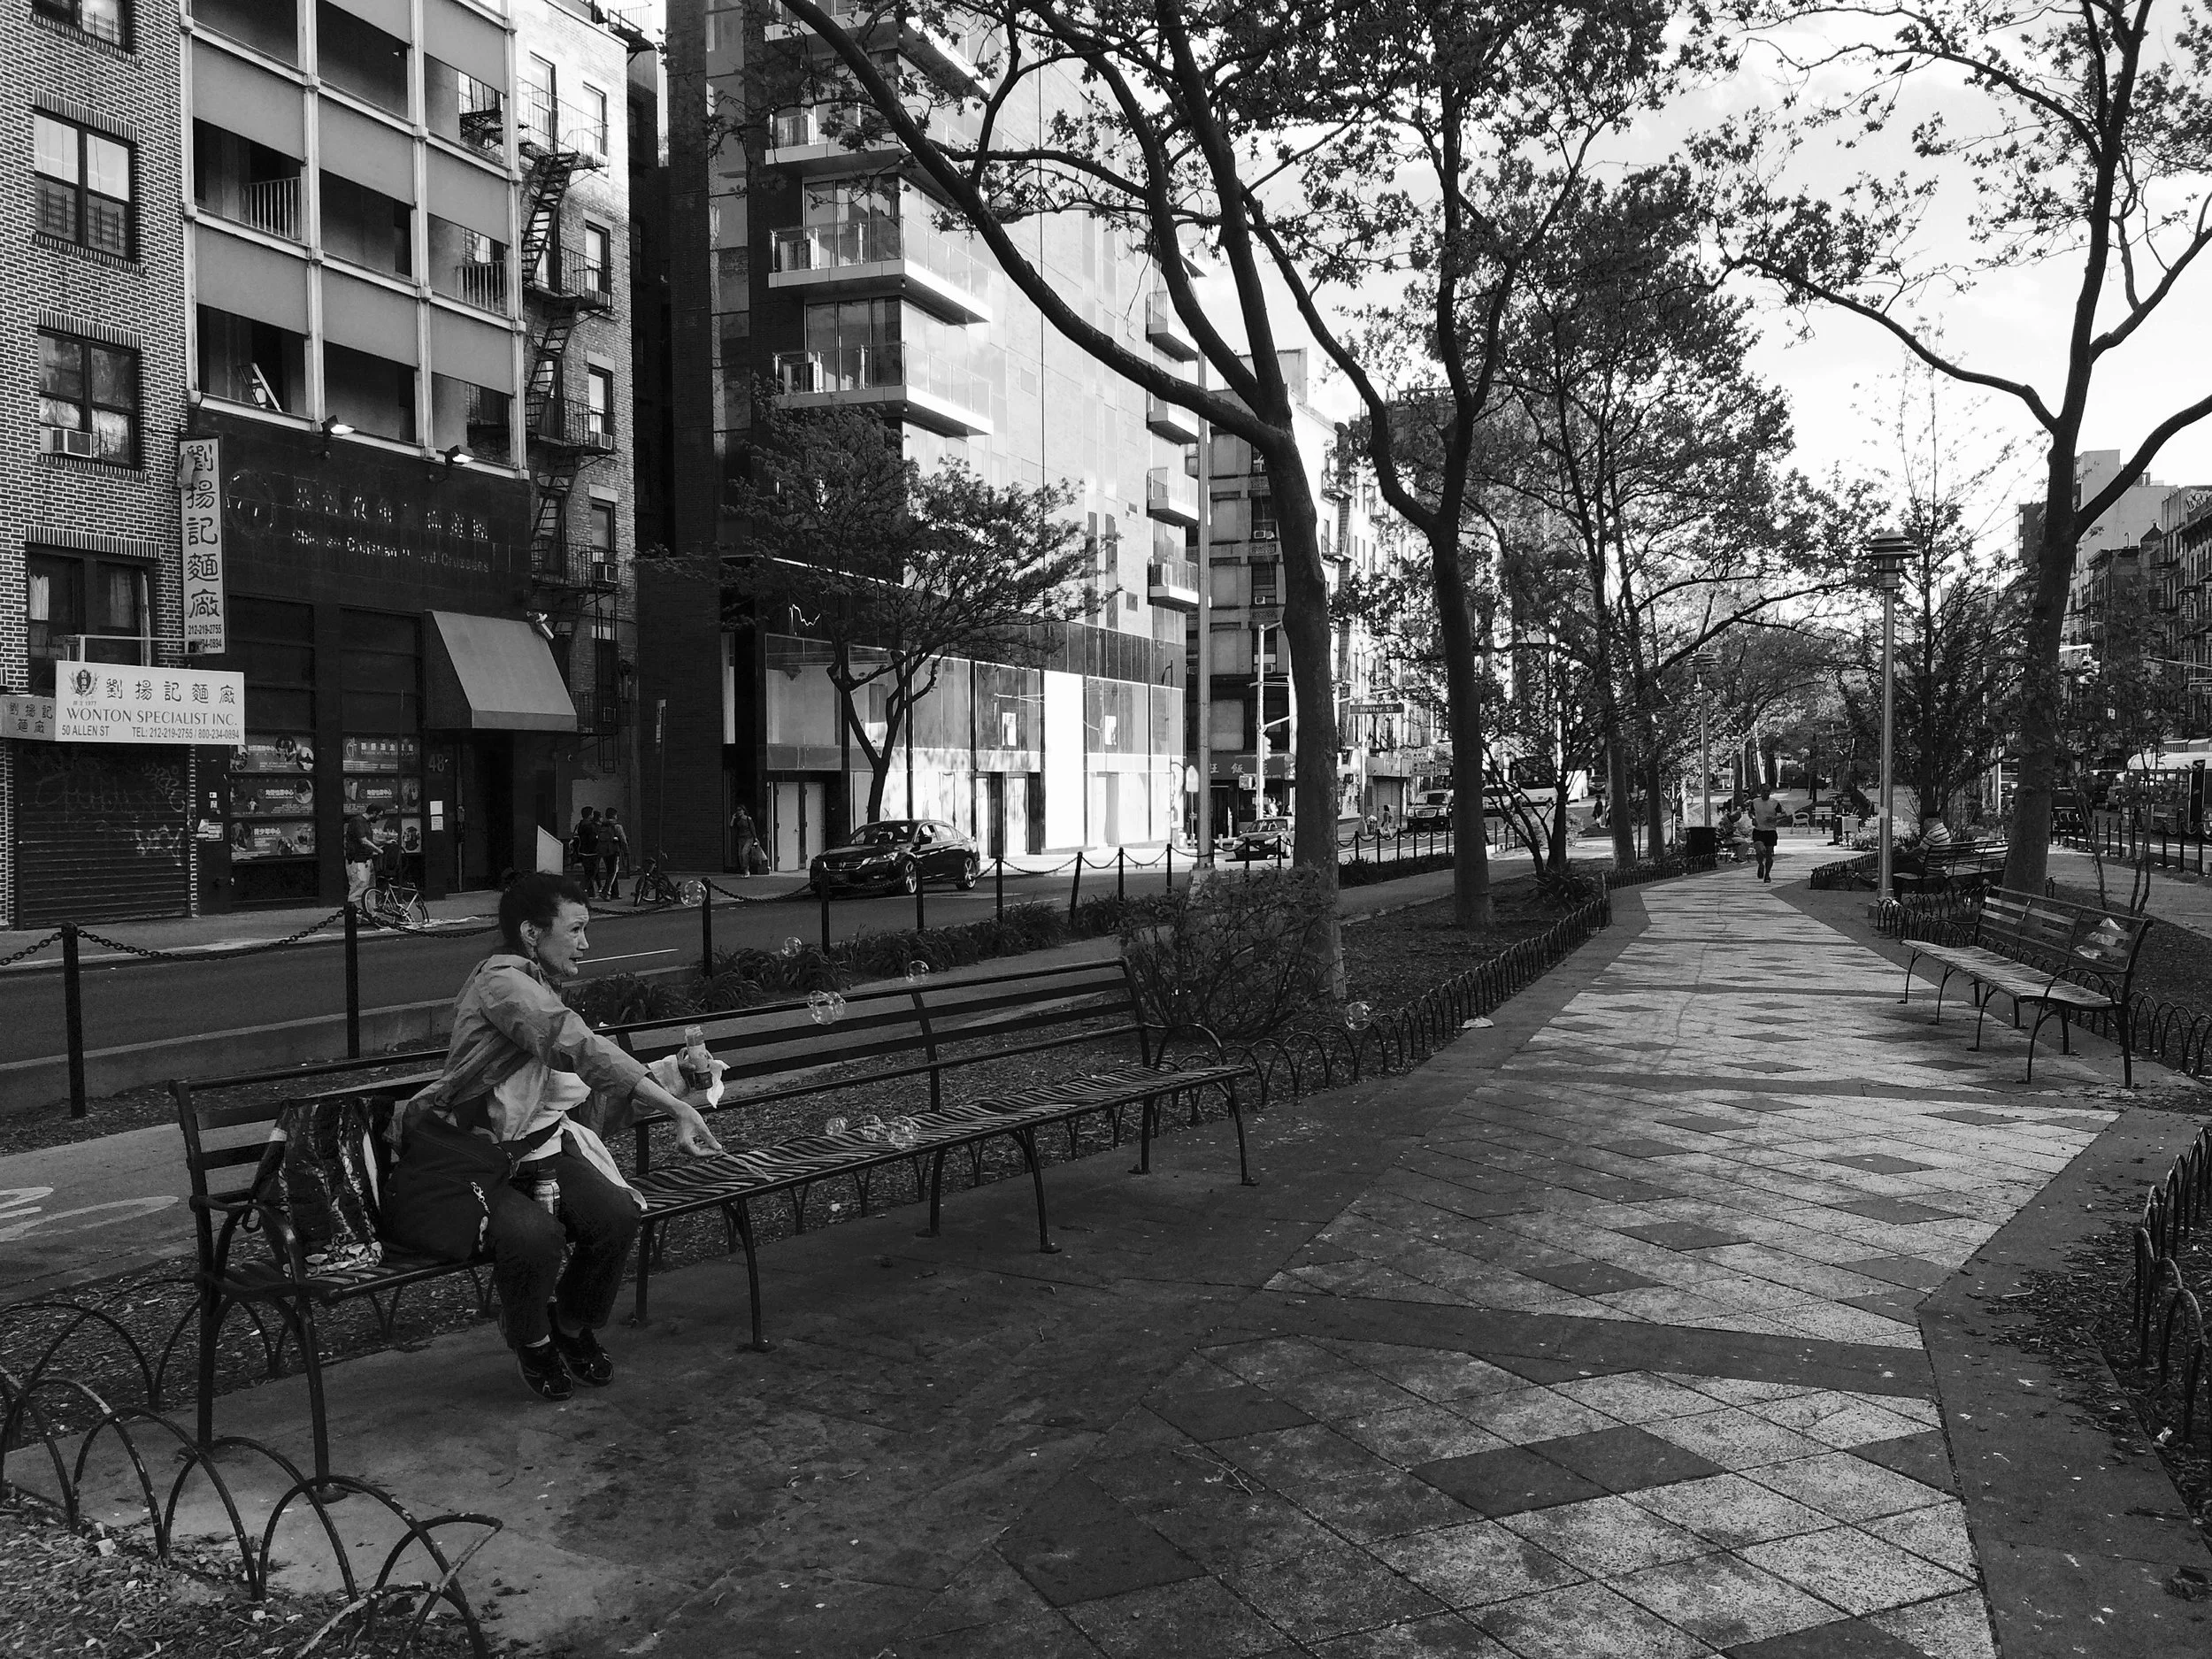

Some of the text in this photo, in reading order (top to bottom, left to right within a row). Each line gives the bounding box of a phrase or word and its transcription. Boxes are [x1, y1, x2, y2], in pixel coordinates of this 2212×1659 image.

[188, 624, 222, 635] 212-219-2755
[105, 678, 235, 705] 劉揚記麵廠
[66, 707, 237, 726] WONTON SPECIALIST INC.
[61, 726, 71, 735] 50
[72, 726, 99, 736] ALLEN
[99, 726, 110, 737] ST
[132, 726, 148, 738] TEL:
[149, 727, 194, 739] 212-219-2755
[198, 728, 240, 740] 800-234-0894
[428, 754, 445, 772] 48
